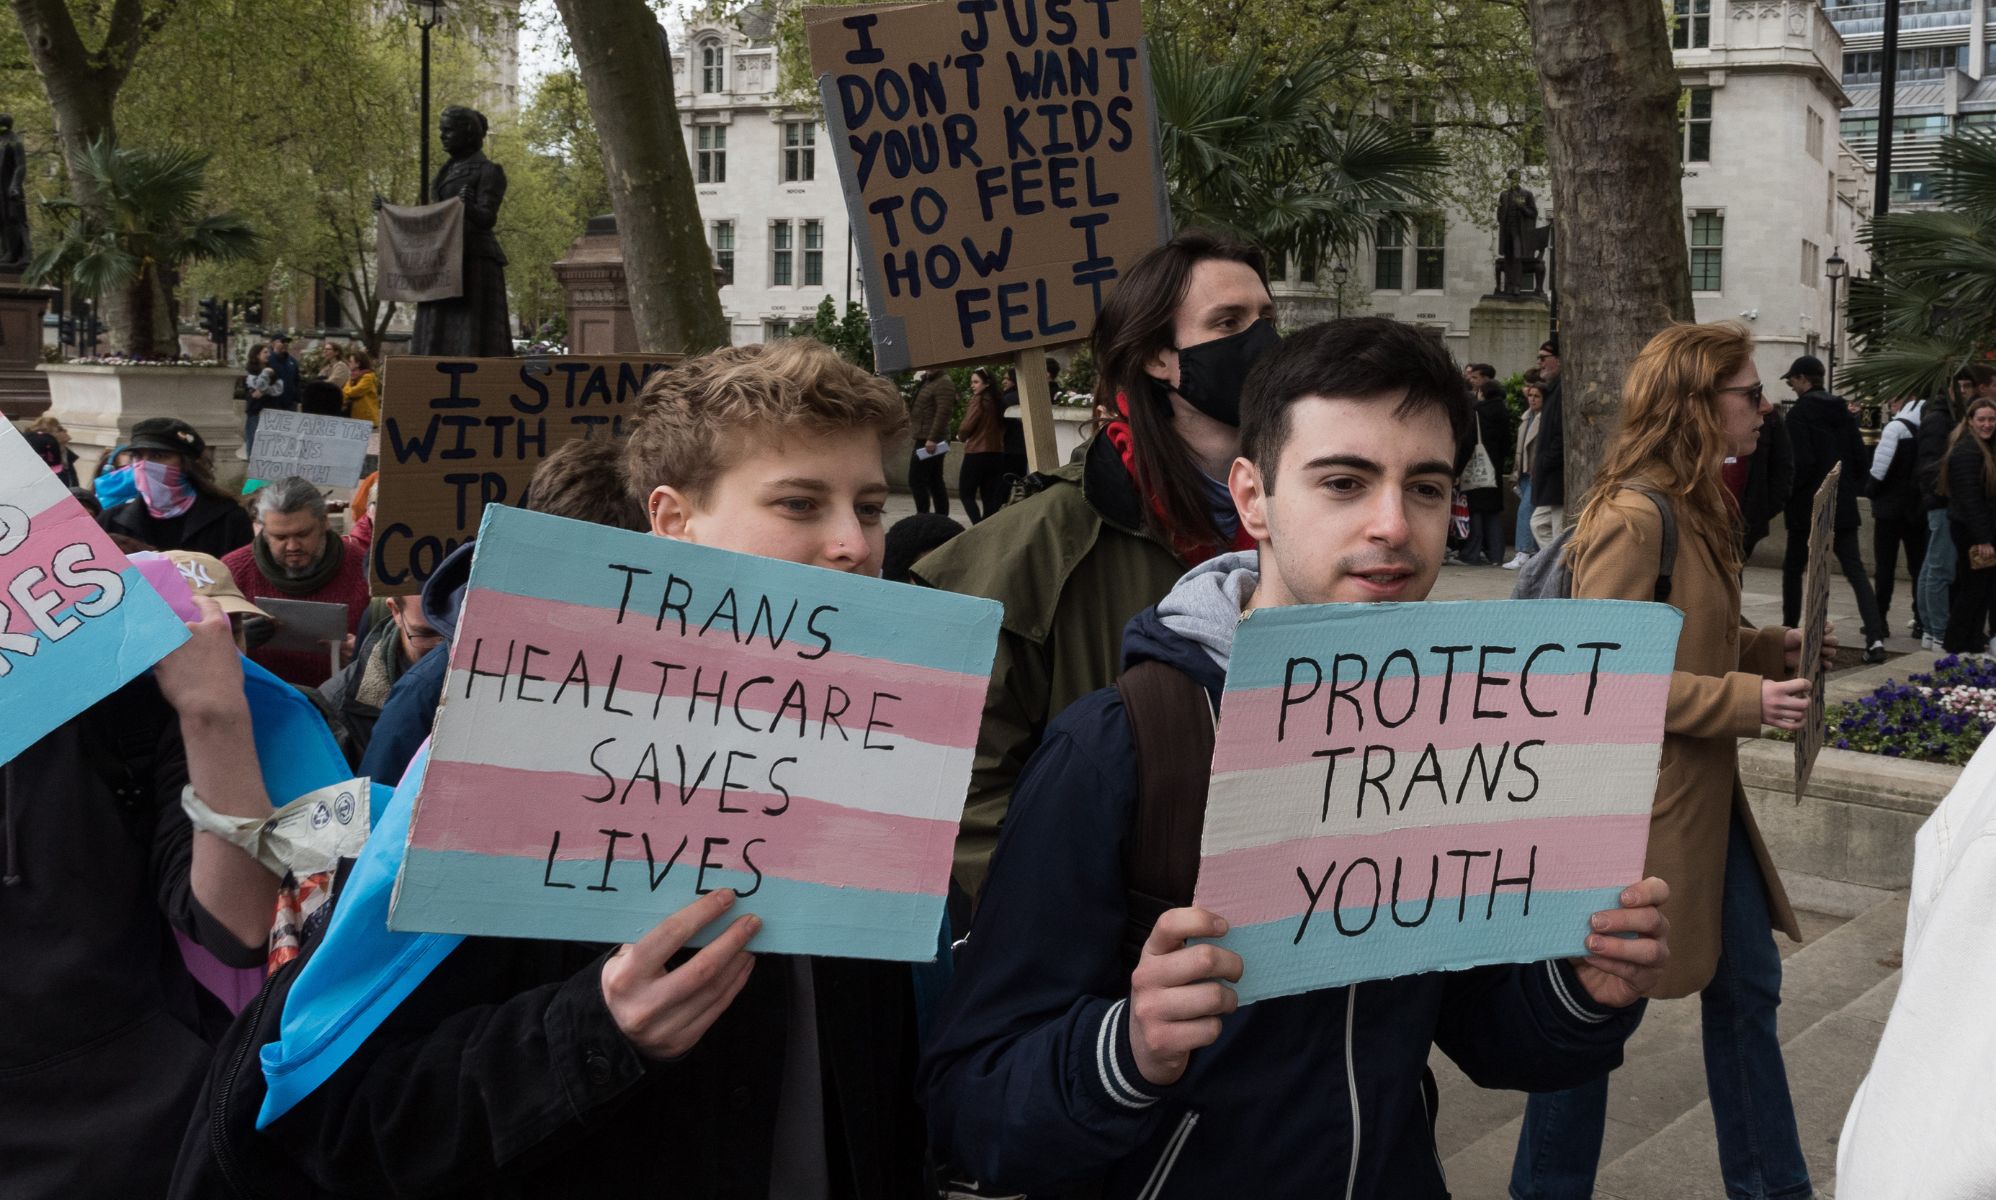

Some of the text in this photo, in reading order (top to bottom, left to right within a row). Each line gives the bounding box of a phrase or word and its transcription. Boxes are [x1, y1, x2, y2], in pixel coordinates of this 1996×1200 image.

[842, 0, 1120, 64] I JUST
[837, 47, 1137, 130] DON'T WANT
[848, 96, 1133, 193] YOUR KIDS
[869, 156, 1119, 247] TO FEEL
[884, 213, 1114, 299] HOW I
[955, 269, 1118, 348] FELT
[263, 411, 293, 432] WE
[297, 416, 338, 437] ARE
[429, 362, 673, 414] I STAN
[256, 459, 331, 483] YOUTH
[257, 433, 322, 459] TRANS
[386, 414, 547, 464] WITH
[608, 564, 839, 660] TRANS
[466, 638, 902, 751] HEALTHCARE
[1278, 642, 1622, 743] PROTECT
[582, 737, 798, 817] SAVES
[1312, 739, 1546, 823] TRANS
[544, 829, 767, 898] LIVES
[1293, 845, 1538, 945] YOUTH
